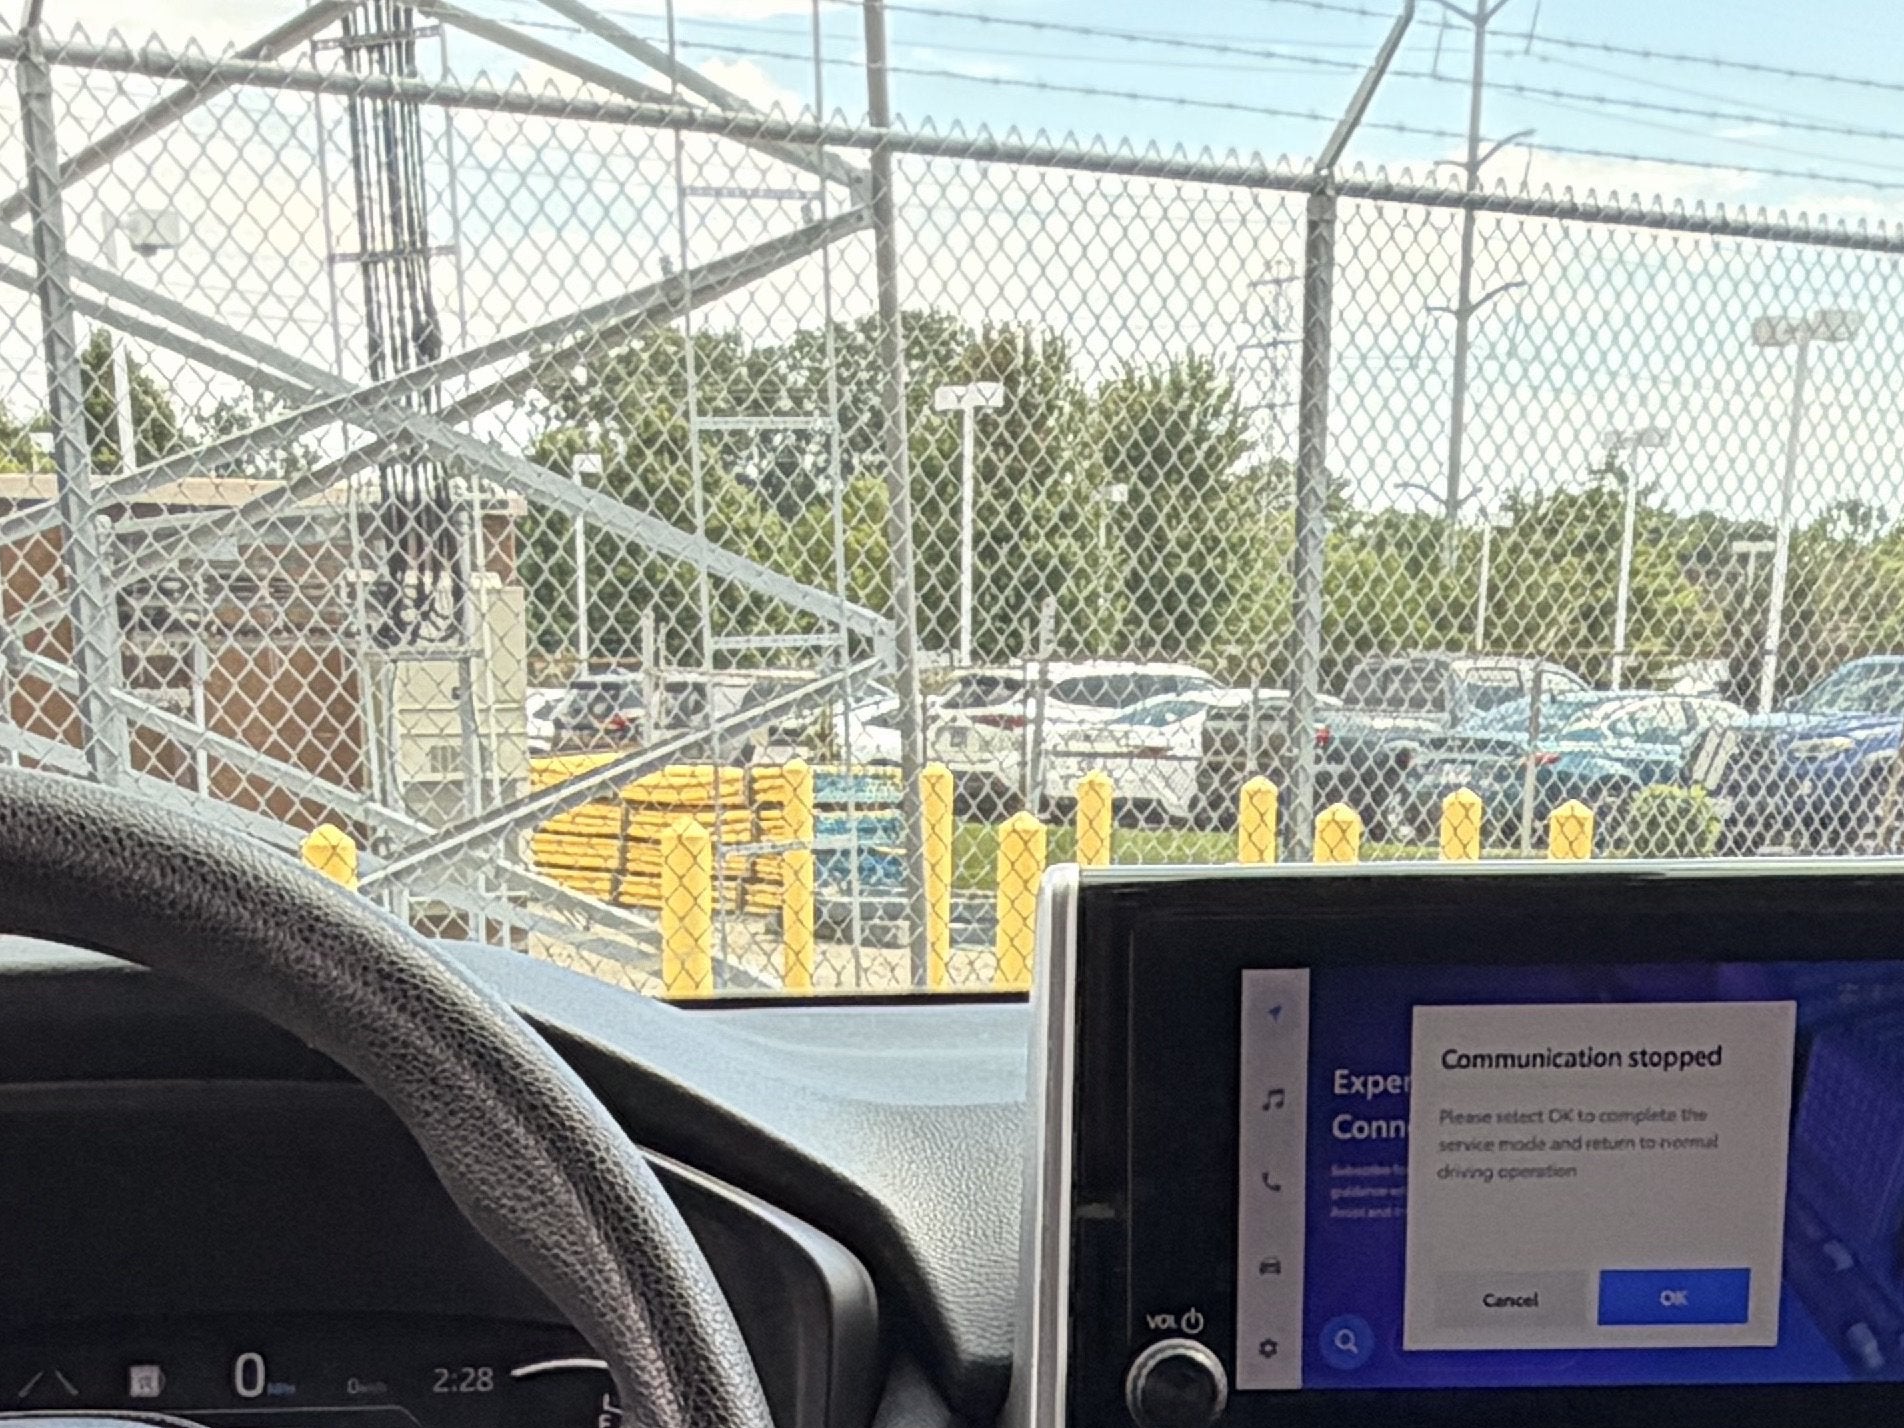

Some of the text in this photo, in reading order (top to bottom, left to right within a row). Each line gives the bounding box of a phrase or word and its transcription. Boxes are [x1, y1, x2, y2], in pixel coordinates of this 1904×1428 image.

[1441, 1044, 1723, 1071] Communication stopped
[1439, 1107, 1708, 1125] Please select OK to complete the
[1438, 1133, 1718, 1151] service mode and return to normal
[1437, 1164, 1494, 1183] driving
[1482, 1291, 1539, 1308] Cancel
[1660, 1290, 1689, 1307] OK
[1146, 1313, 1177, 1330] VOL
[234, 1352, 266, 1398] 0
[432, 1368, 494, 1393] 2:28
